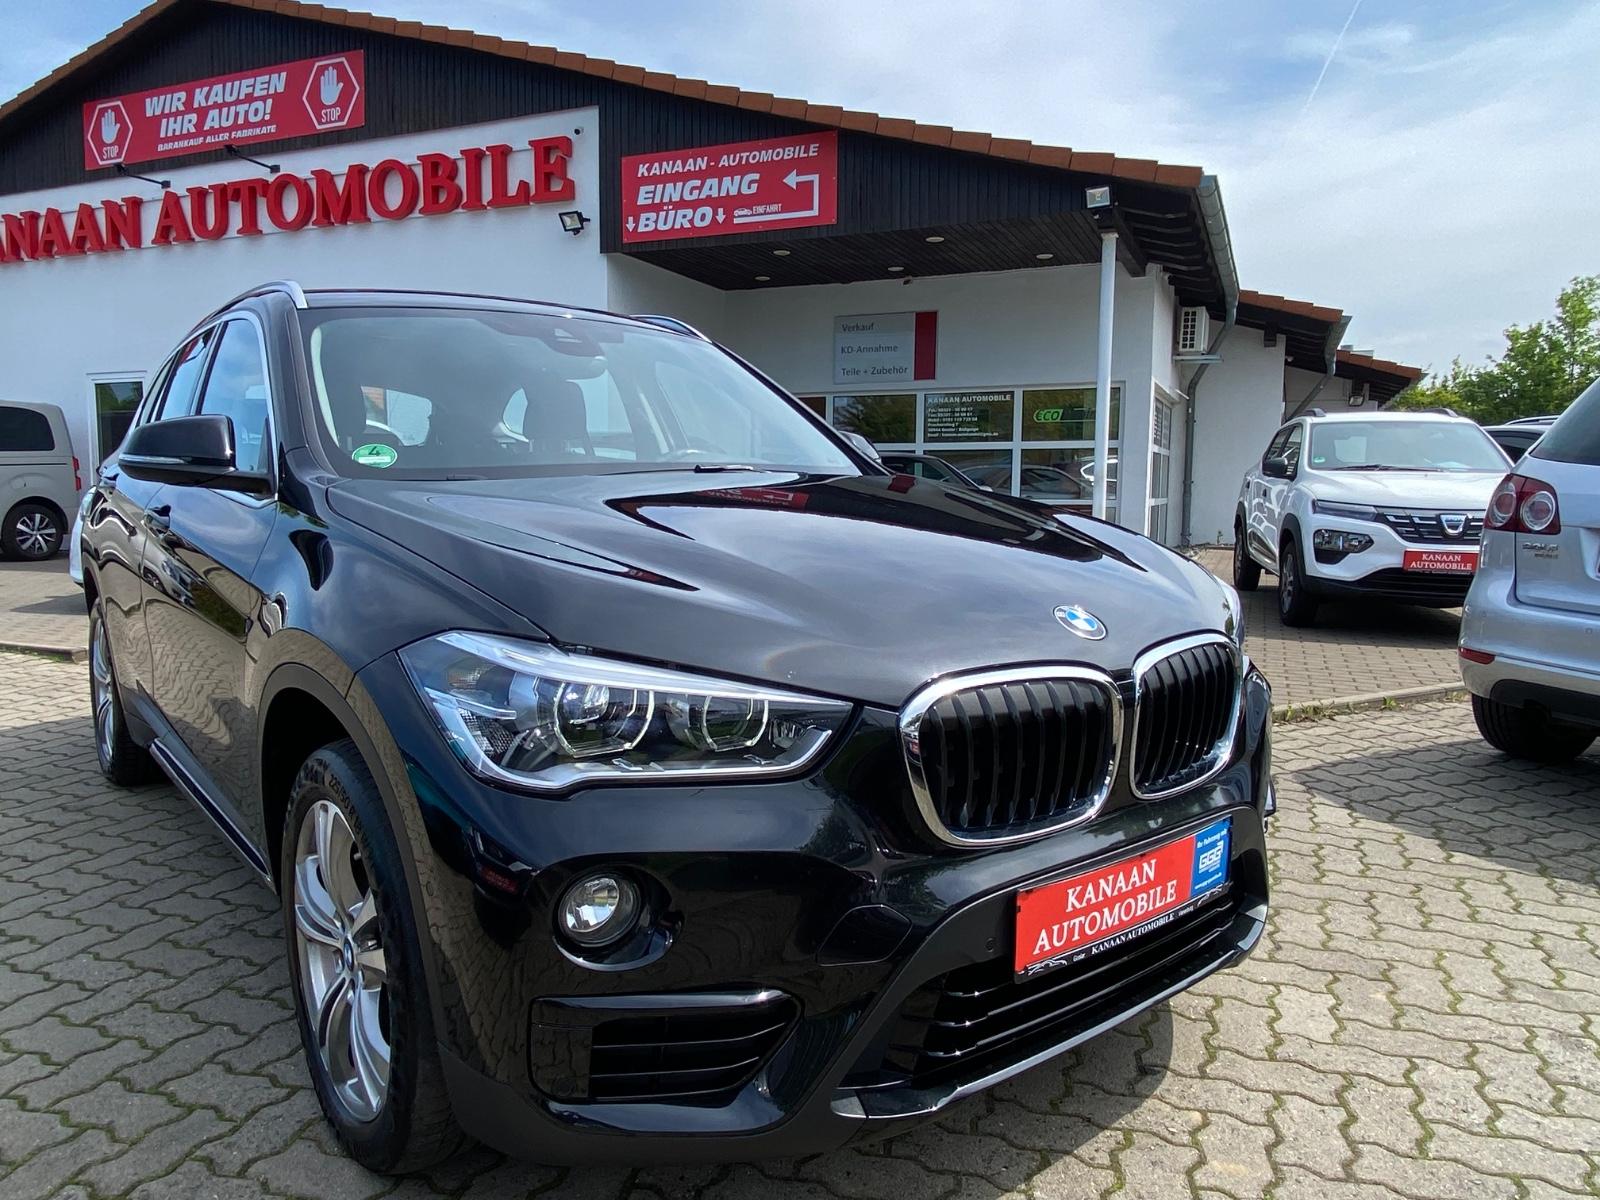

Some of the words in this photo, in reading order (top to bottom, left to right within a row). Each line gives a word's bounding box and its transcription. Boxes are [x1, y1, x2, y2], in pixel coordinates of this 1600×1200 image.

[145, 92, 186, 117] WIR
[193, 72, 287, 108] KAUFEN
[159, 113, 198, 138] IHR
[204, 99, 273, 130] AUTO!
[321, 107, 341, 123] STOP
[205, 132, 229, 143] ALLER
[231, 125, 276, 139] FABRIKATE
[102, 145, 119, 160] STOP
[637, 156, 708, 177] KANAAN
[719, 143, 819, 168] AUTOMOBILE
[152, 135, 575, 245] AUTOMOBILE
[637, 173, 760, 205] EINGANG
[753, 204, 782, 215] EINFAHRT
[637, 205, 713, 232] BÜRO
[842, 322, 875, 332] Verkauf
[841, 344, 898, 354] KD-Annahme
[842, 367, 861, 376] Teile
[870, 365, 908, 376] Zubehör
[927, 396, 960, 404] KANAAN
[961, 394, 1011, 403] AUTOMOBILE
[368, 446, 381, 456] 4
[1410, 561, 1472, 571] AUTOMOBILE
[1422, 553, 1461, 562] KANAAN
[1066, 859, 1157, 912] KANAAN
[1032, 880, 1177, 954] AUTOMOBILE
[1091, 936, 1127, 955] KANAAN
[1127, 913, 1175, 940] AUTOMOBILE
